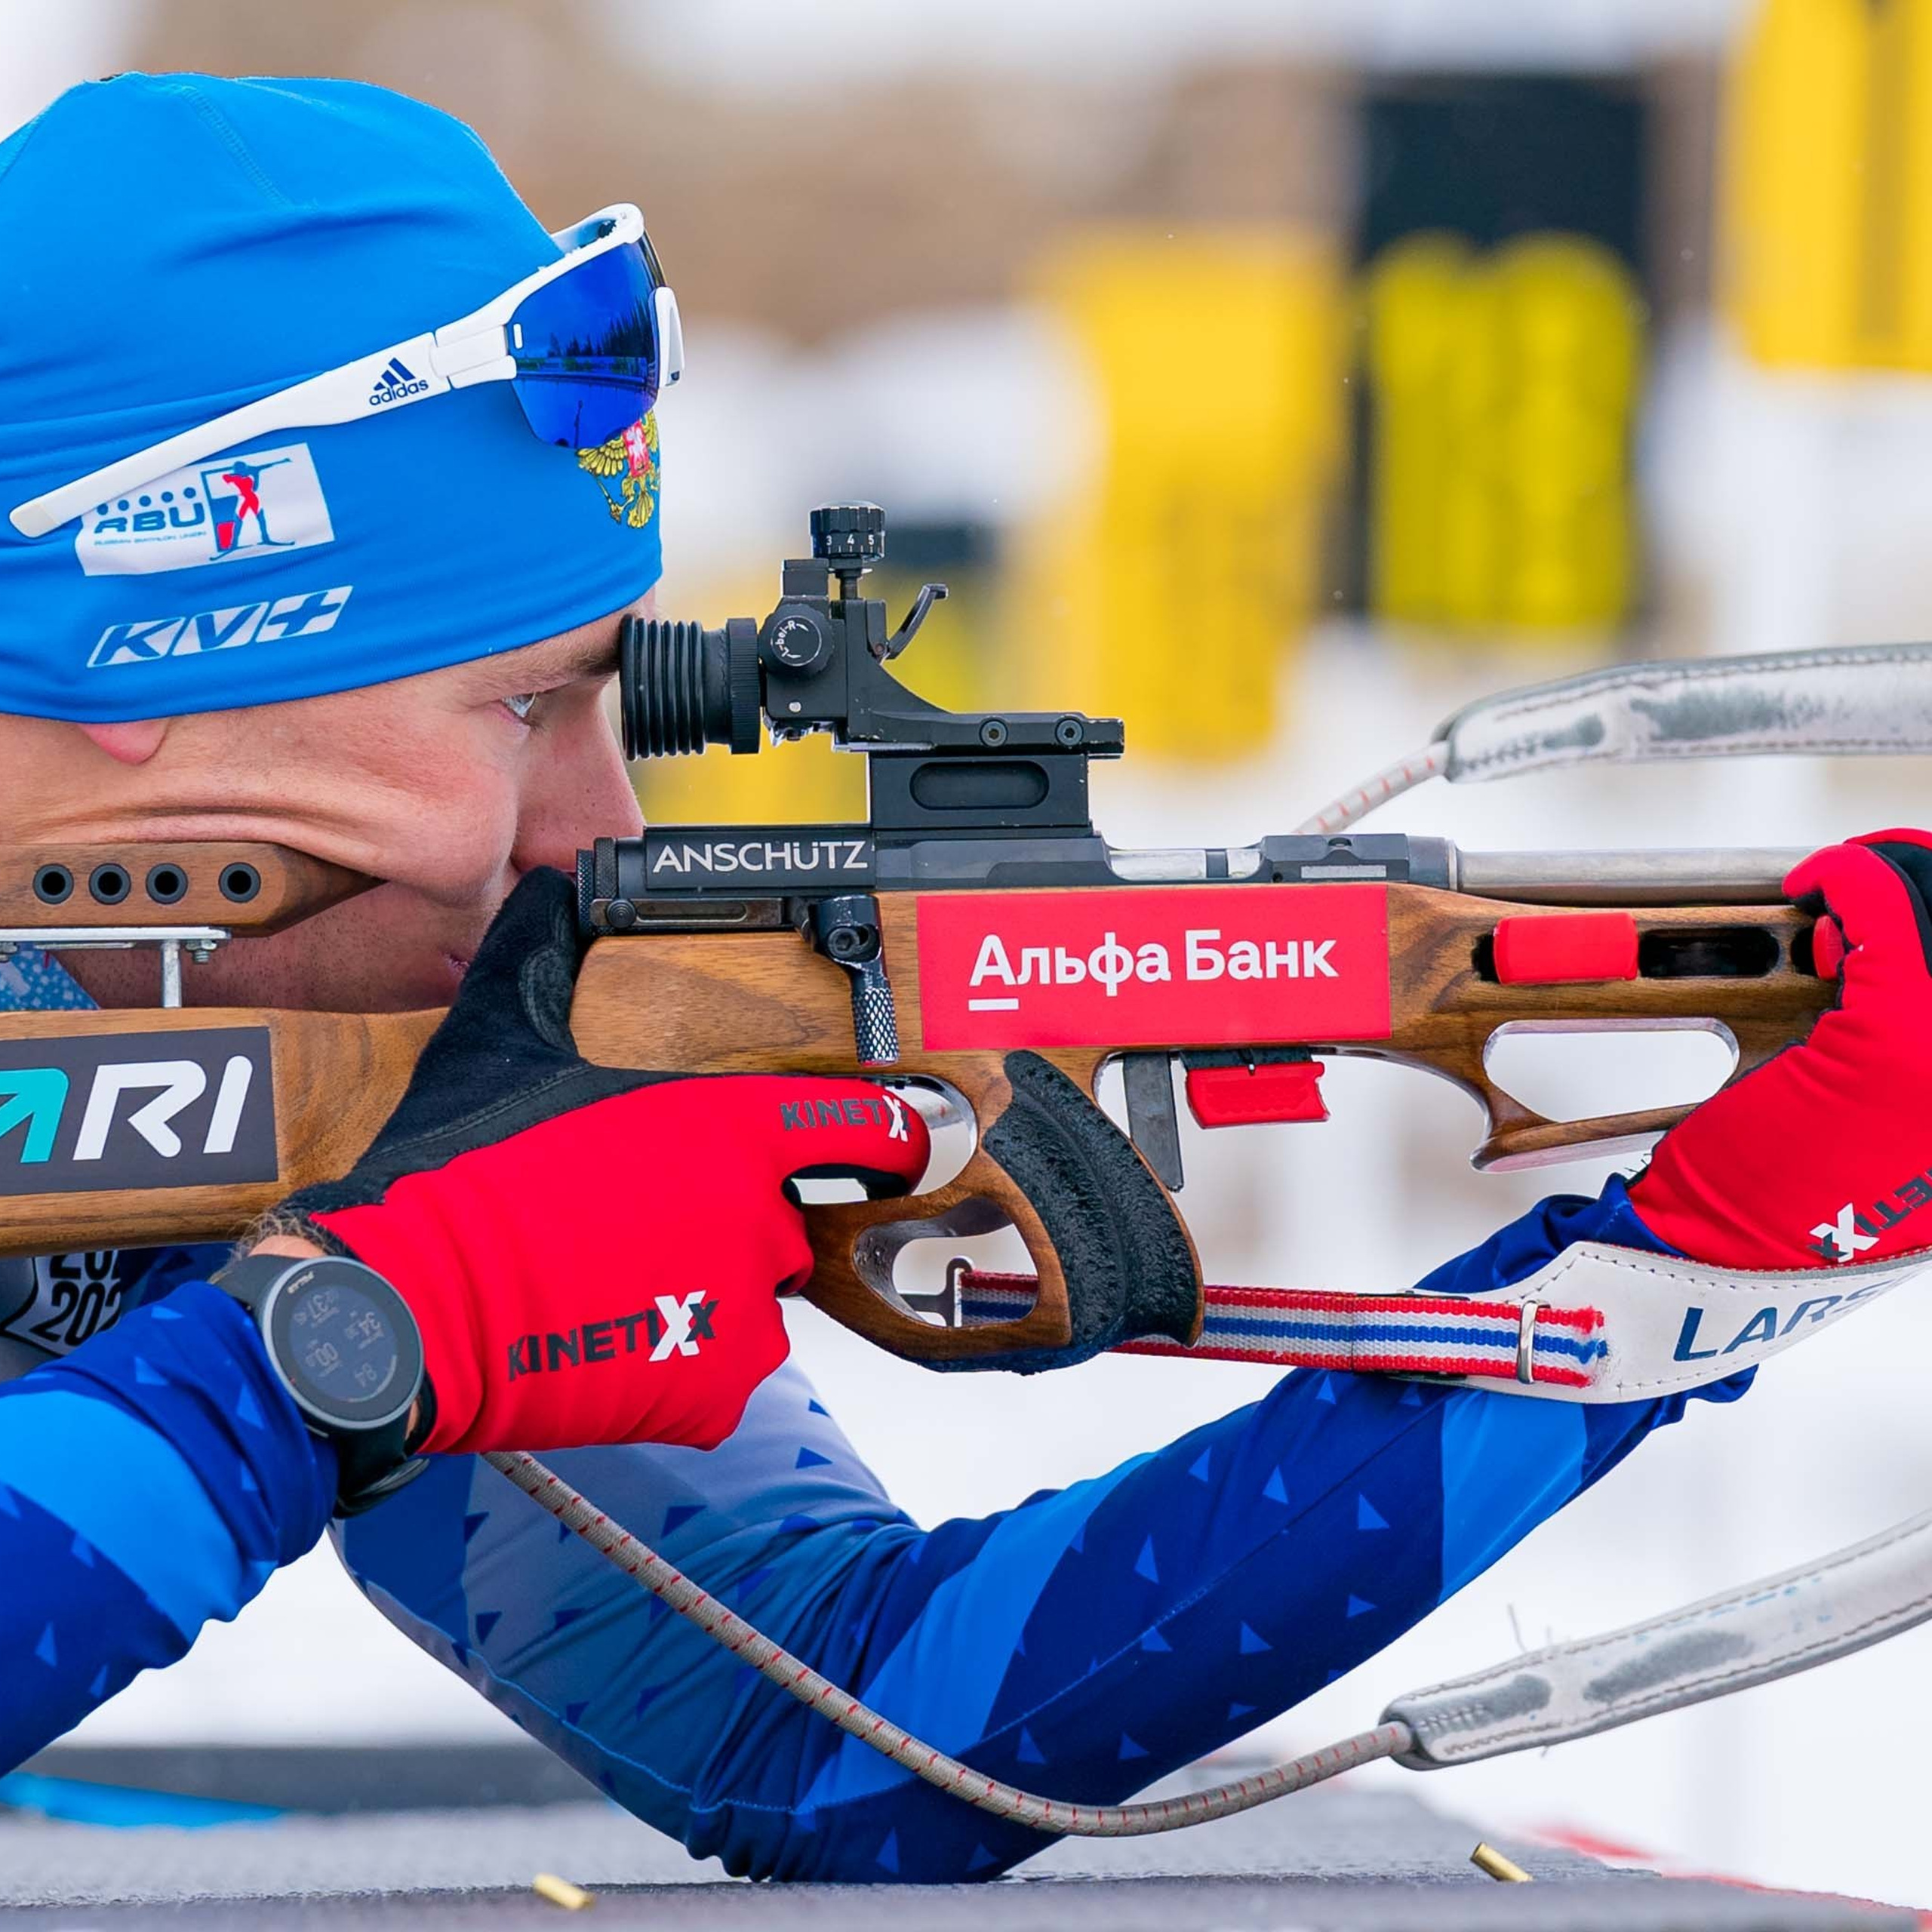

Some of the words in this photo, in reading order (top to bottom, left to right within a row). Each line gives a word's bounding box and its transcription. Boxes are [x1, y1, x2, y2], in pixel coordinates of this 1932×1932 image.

[368, 377, 429, 406] adidas
[94, 502, 205, 534] RBU
[826, 534, 832, 546] 3
[847, 533, 855, 545] 4
[868, 534, 875, 546] 5
[653, 840, 869, 873] ANSCHÜTZ
[968, 931, 1172, 997] Альфа
[1184, 928, 1339, 980] Банк
[1806, 1167, 1932, 1263] ETIXX
